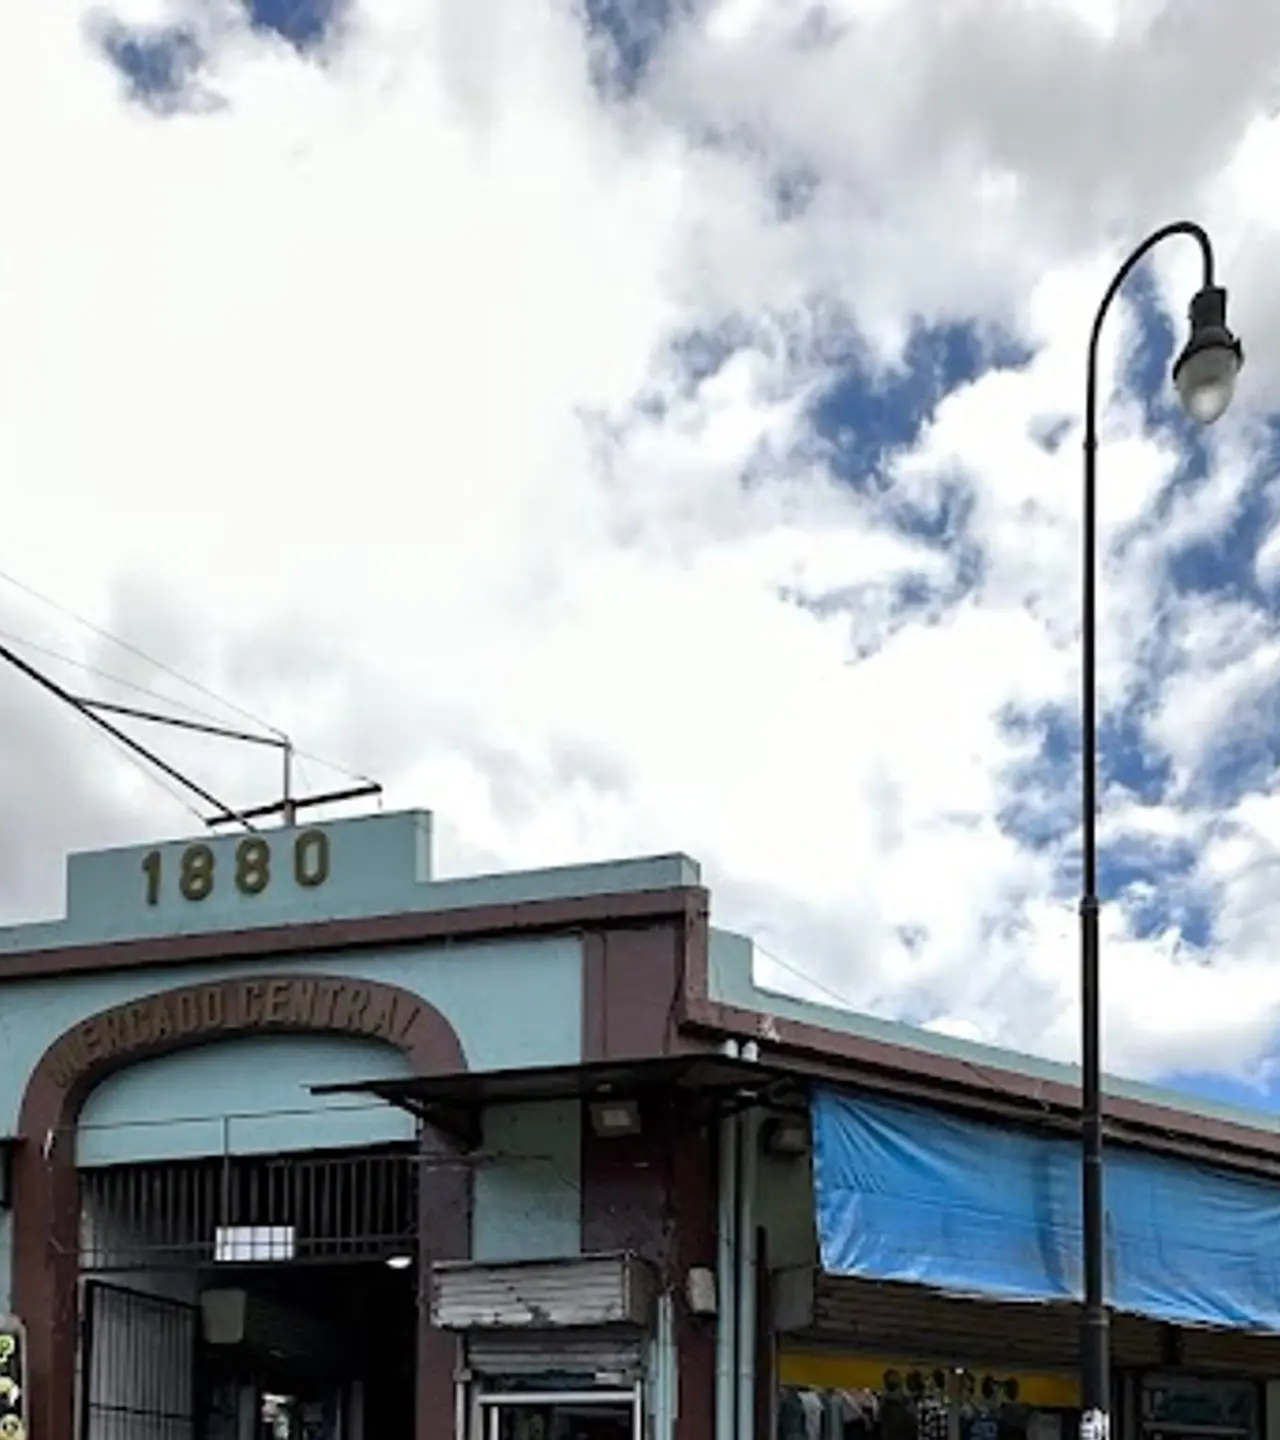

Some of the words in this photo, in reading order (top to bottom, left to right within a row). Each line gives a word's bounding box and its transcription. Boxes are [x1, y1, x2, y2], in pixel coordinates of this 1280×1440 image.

[142, 829, 329, 906] 1880
[50, 984, 222, 1088] MERCADO
[242, 978, 420, 1051] CENTRAL
